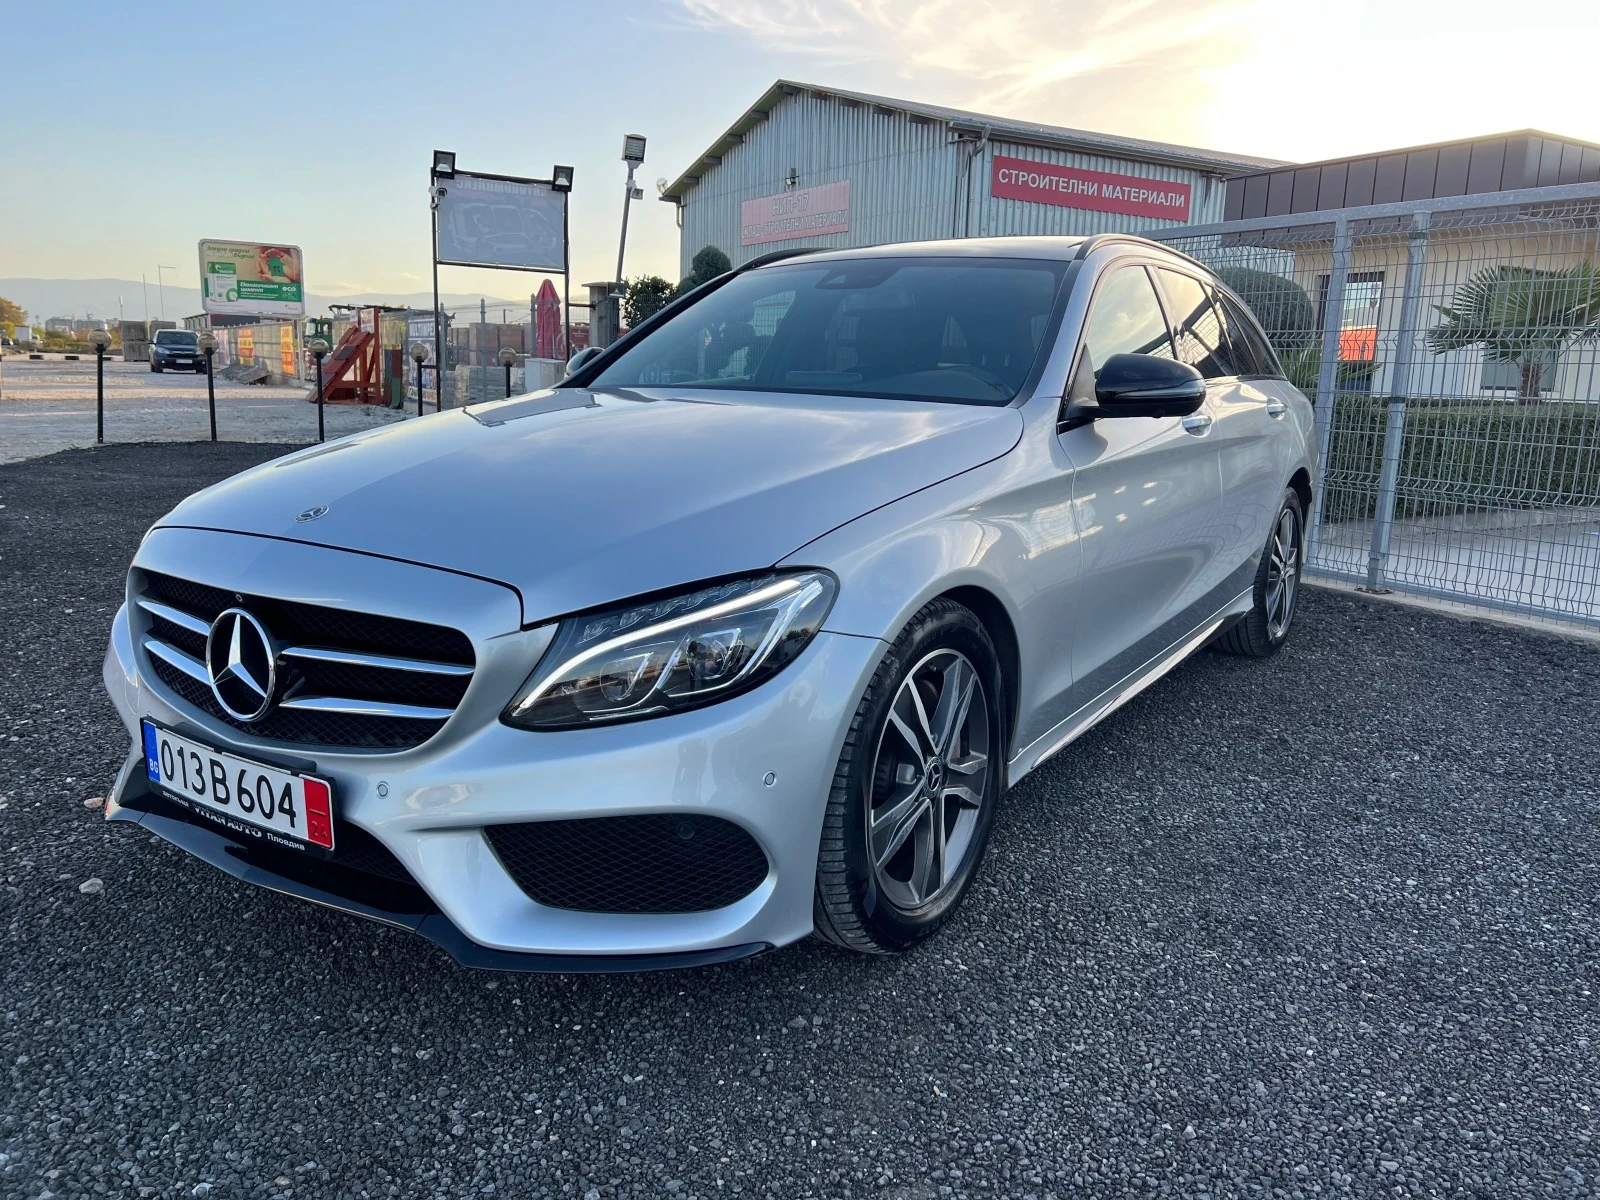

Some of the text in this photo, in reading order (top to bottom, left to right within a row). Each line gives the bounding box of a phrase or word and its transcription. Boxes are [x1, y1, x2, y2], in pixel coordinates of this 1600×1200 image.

[998, 168, 1185, 208] СТРОИТЕЛНИ МАТЕРИАЛИ
[149, 758, 159, 774] BG
[226, 817, 263, 838] AUTO
[266, 831, 306, 851] Пловдив
